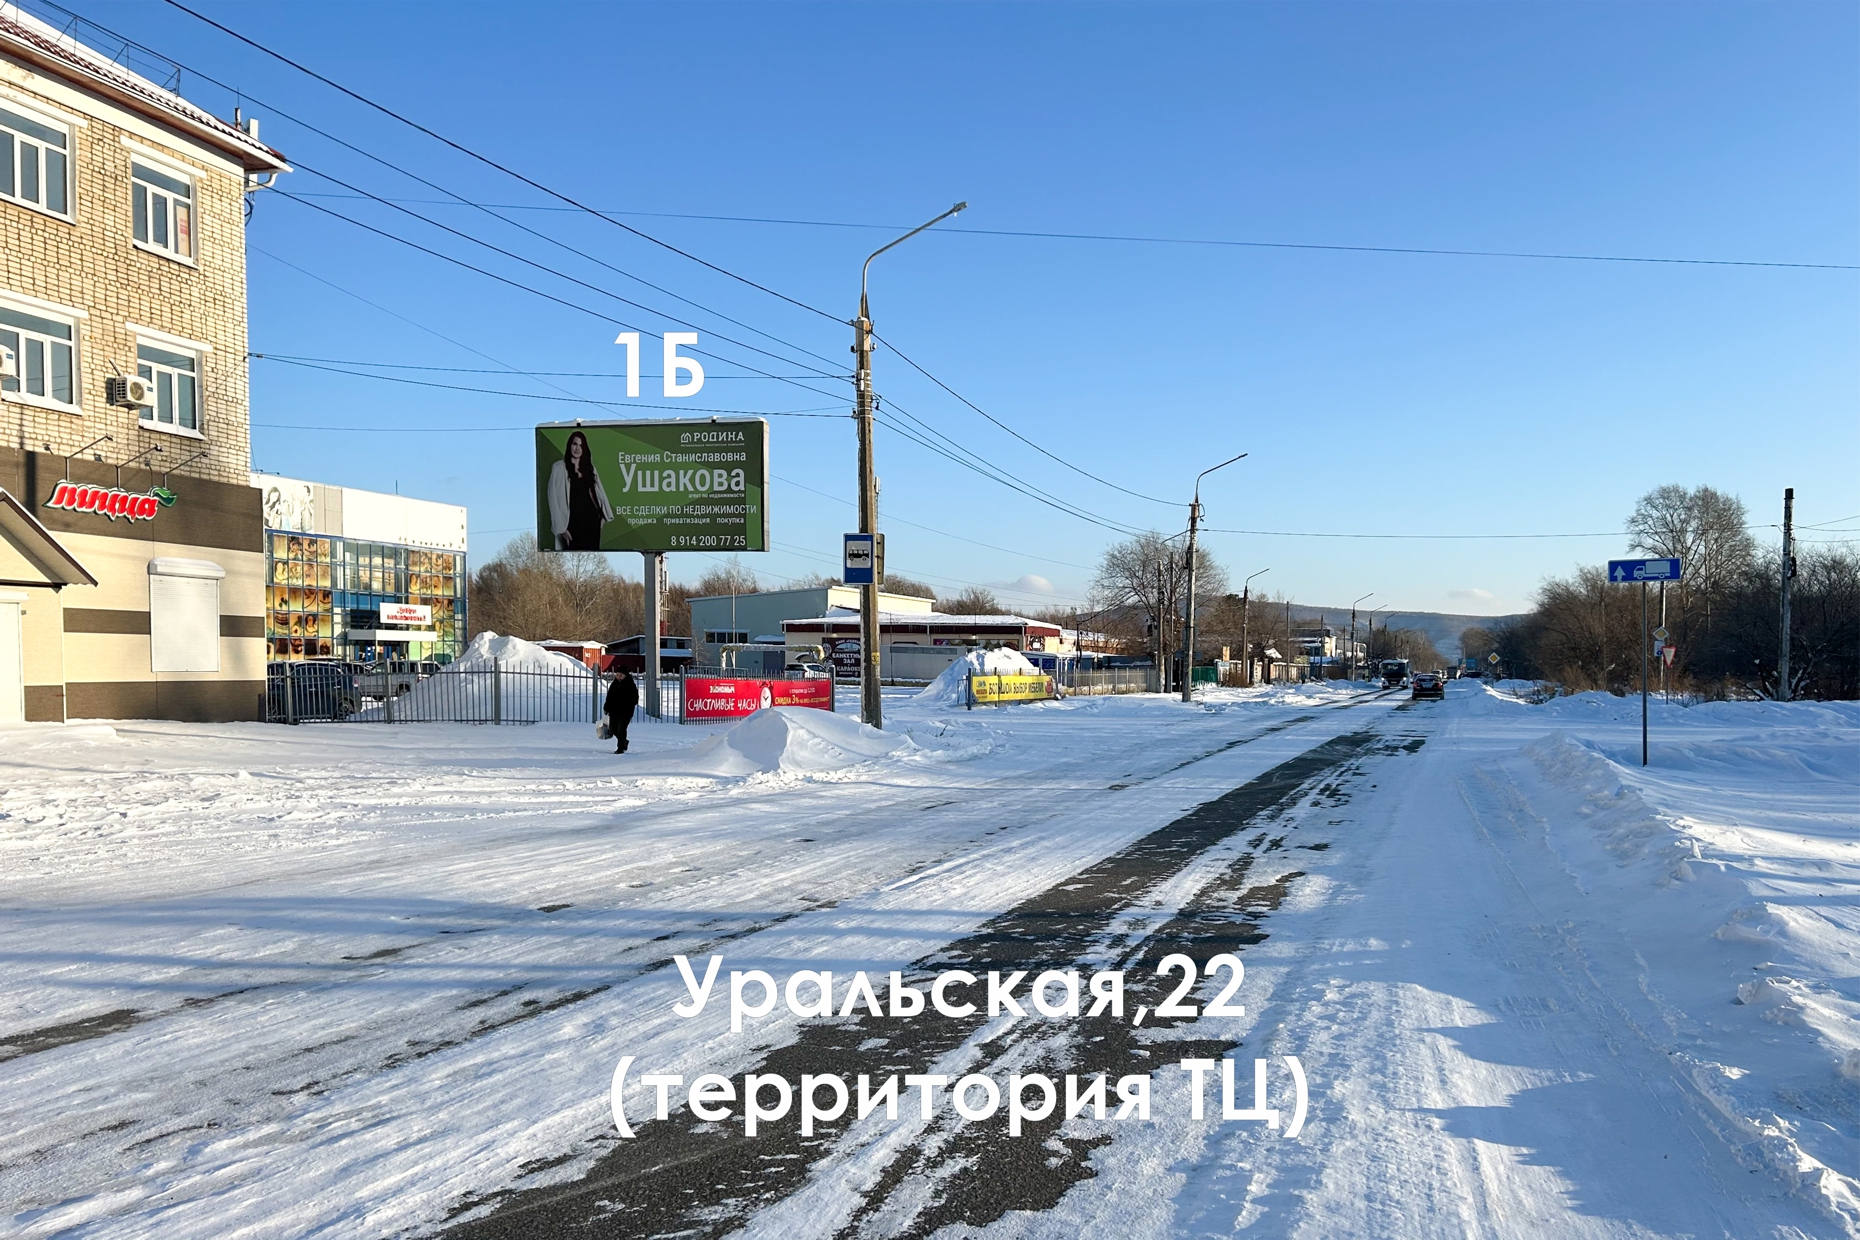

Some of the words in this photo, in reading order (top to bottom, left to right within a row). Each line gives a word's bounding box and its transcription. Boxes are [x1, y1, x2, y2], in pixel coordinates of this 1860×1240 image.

[693, 431, 745, 442] РОДИНА
[618, 451, 661, 464] Евгения
[663, 451, 747, 463] Станиславовна
[619, 463, 746, 493] Ушакова
[616, 505, 632, 515] ВСЕ
[633, 505, 668, 517] СДЕЛКИ
[669, 505, 682, 515] ПО
[683, 504, 757, 516] НЕДВИЖИМОСТИ
[627, 517, 657, 526] продажа
[663, 517, 710, 526] приватизация
[716, 517, 745, 526] покупка
[670, 535, 677, 546] 8
[679, 535, 697, 546] 914
[699, 535, 717, 546] 200
[719, 535, 731, 546] 77
[733, 535, 746, 546] 25
[687, 698, 735, 711] СЧАСТЛИВЫЕ
[737, 697, 757, 711] ЧАСЫ
